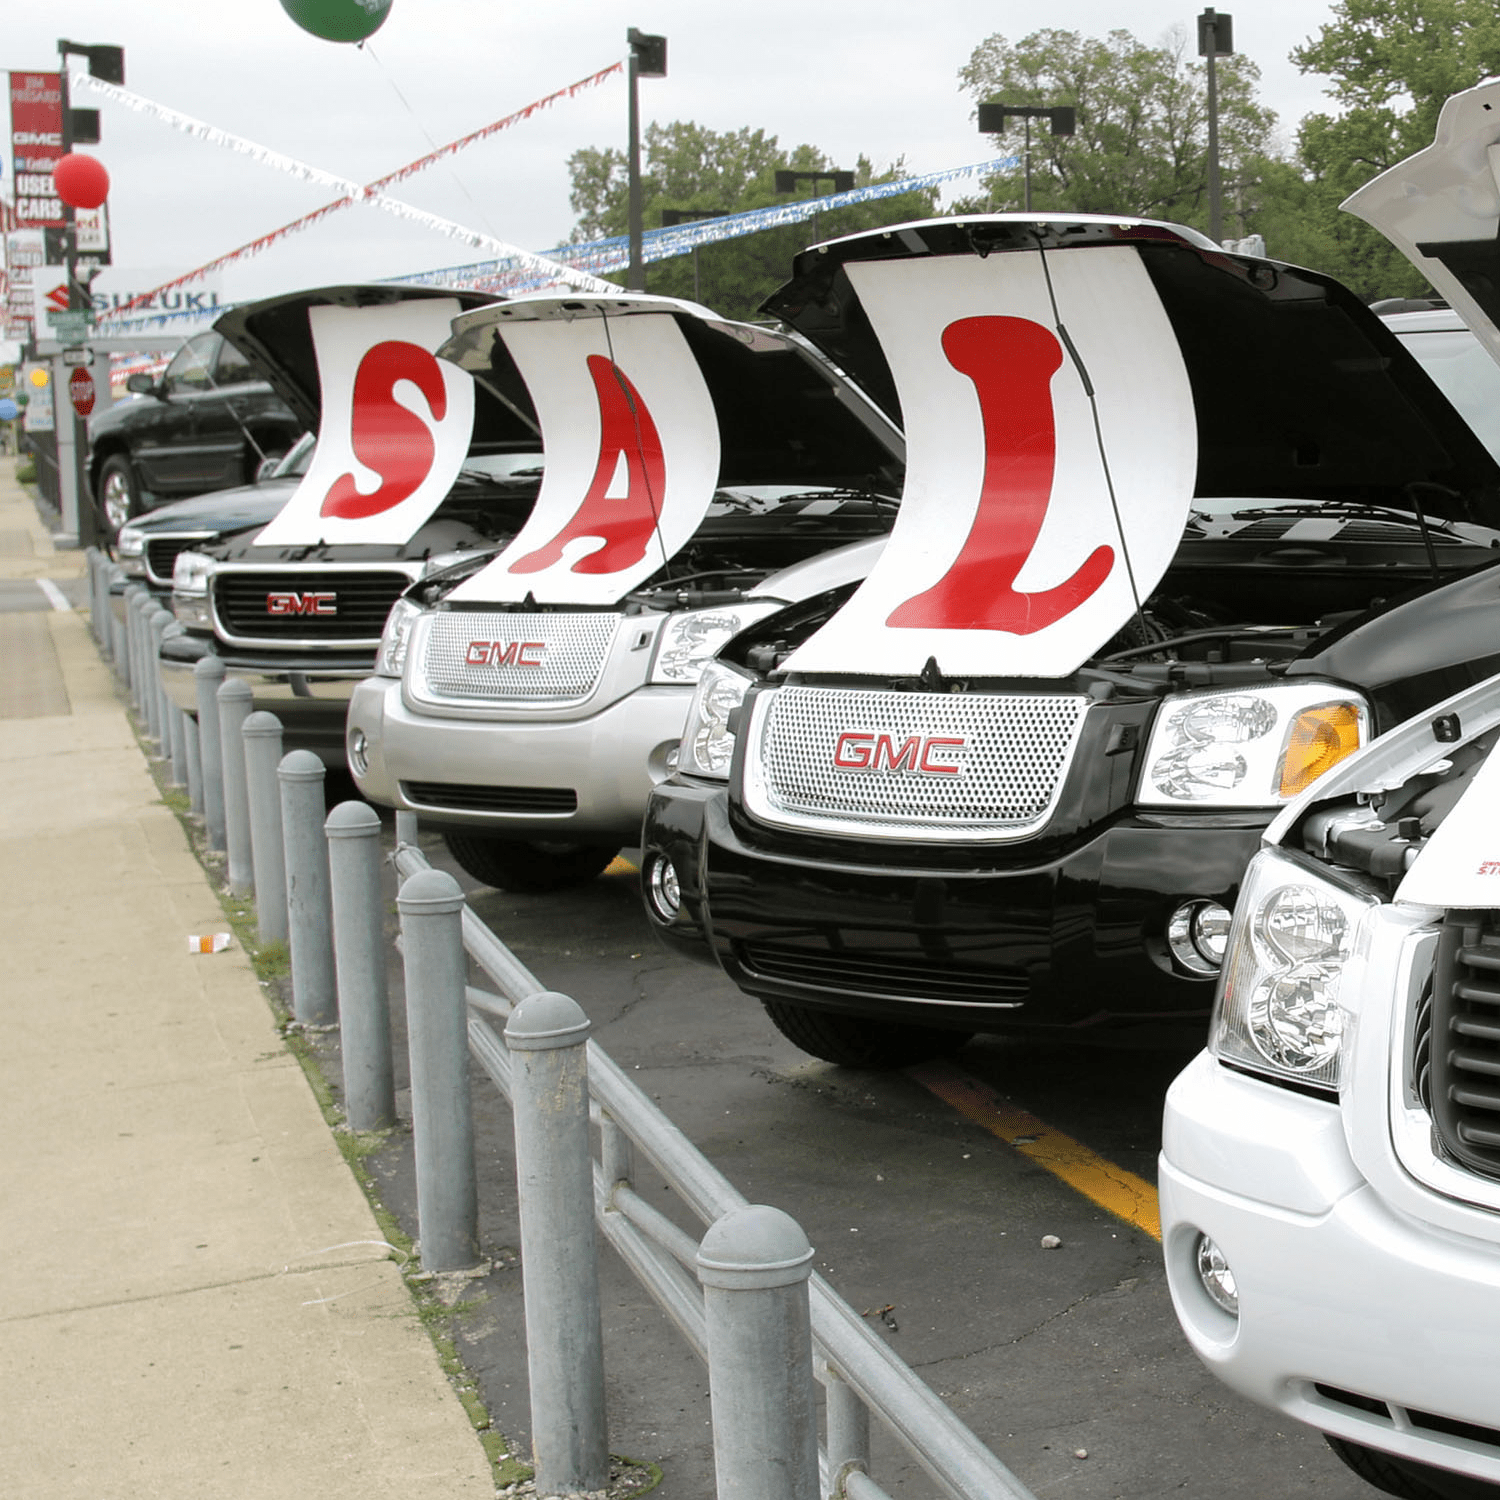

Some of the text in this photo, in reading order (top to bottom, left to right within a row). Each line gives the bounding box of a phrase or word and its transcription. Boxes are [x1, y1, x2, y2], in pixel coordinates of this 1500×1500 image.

[13, 131, 62, 146] GMC
[17, 198, 62, 219] CARS
[92, 293, 217, 309] SUZUKI
[320, 340, 447, 519] S
[508, 354, 666, 574] A
[885, 315, 1115, 635] L
[266, 592, 337, 615] GMC
[465, 641, 547, 668] GMC
[834, 731, 968, 776] GMC
